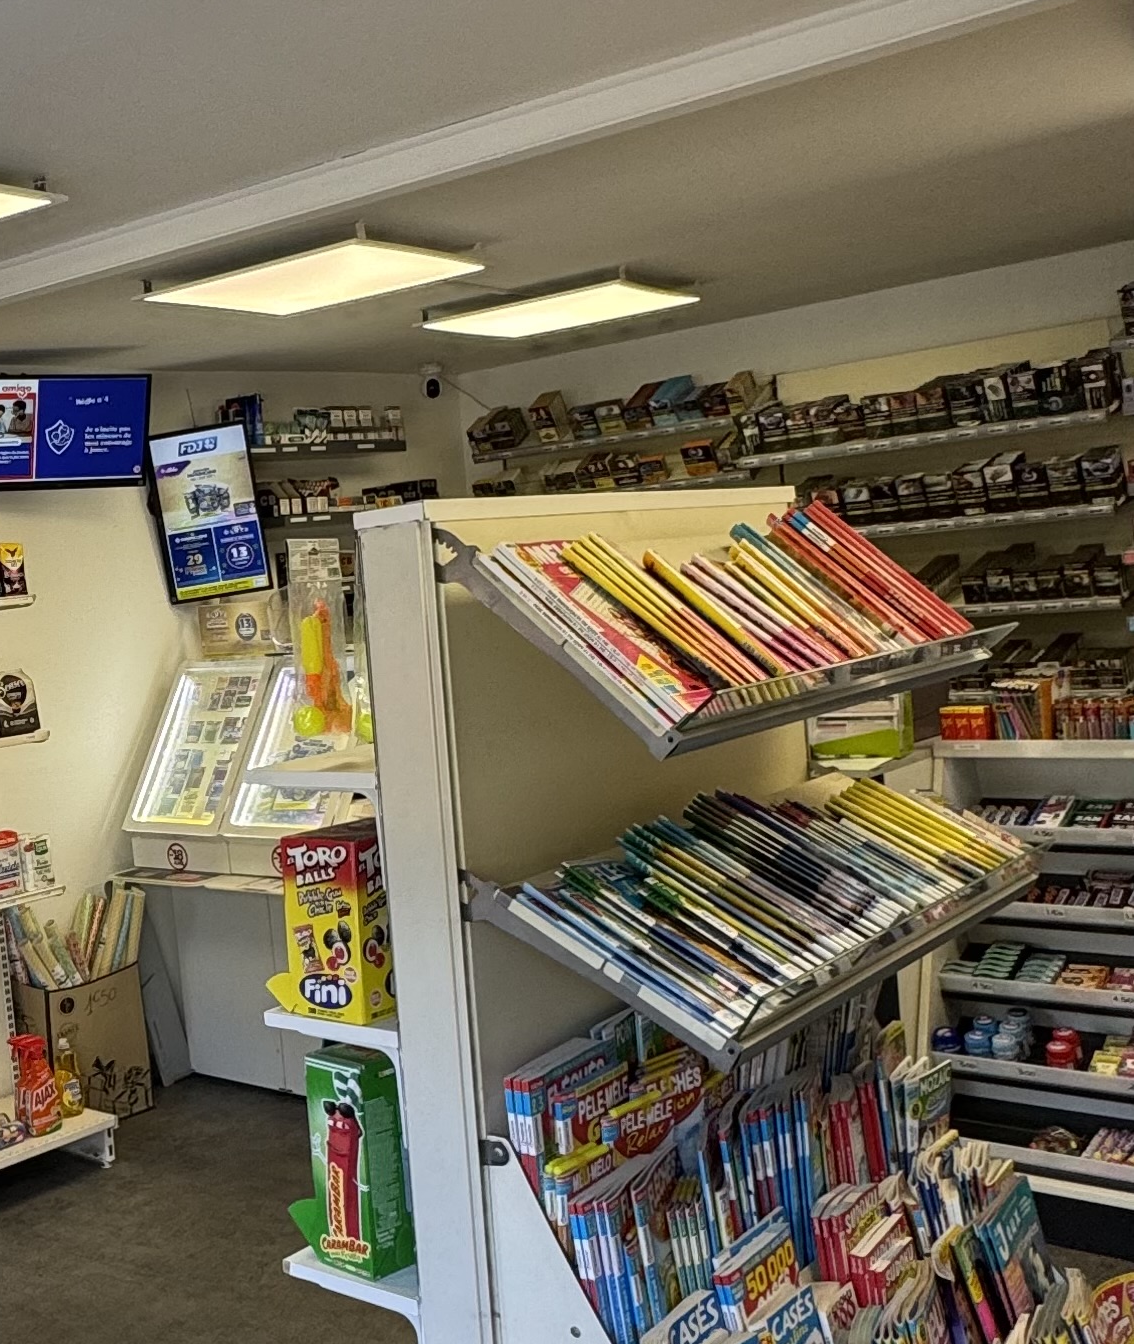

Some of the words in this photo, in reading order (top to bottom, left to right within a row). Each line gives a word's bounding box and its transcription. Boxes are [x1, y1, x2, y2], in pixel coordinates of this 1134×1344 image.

[2, 384, 32, 394] amigo
[180, 441, 203, 455] FDJ
[186, 554, 203, 566] 29
[230, 546, 248, 558] 13
[287, 843, 347, 870] TORO
[296, 866, 337, 888] BALLS
[304, 977, 347, 1006] Fini
[34, 1082, 57, 1108] AJAX
[626, 1125, 665, 1155] Relax
[321, 1237, 370, 1257] CARAMBAR
[745, 1265, 768, 1302] 50
[765, 1238, 797, 1279] 000
[772, 1292, 815, 1343] CASÉS
